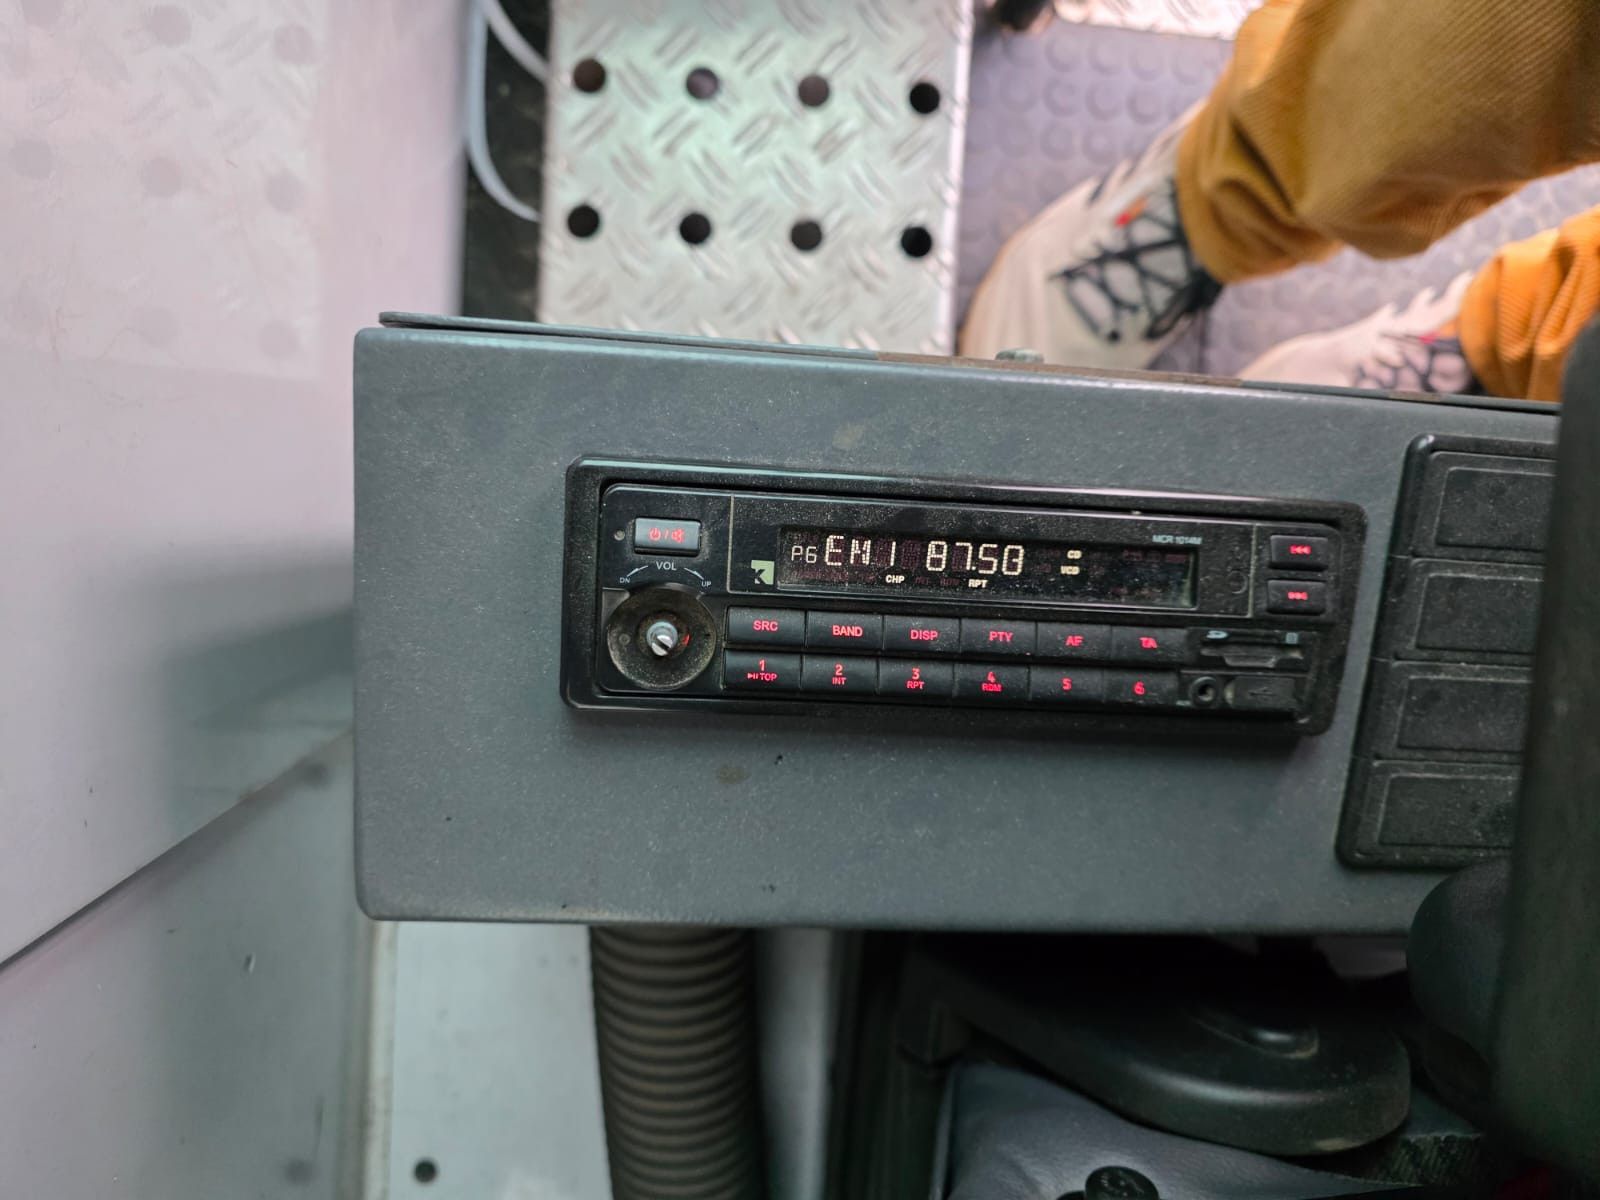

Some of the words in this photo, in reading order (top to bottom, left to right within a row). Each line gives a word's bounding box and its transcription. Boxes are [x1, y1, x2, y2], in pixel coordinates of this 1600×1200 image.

[656, 561, 677, 571] VOL
[753, 620, 778, 632] SRC
[832, 624, 863, 637] BAND
[910, 629, 938, 641] DISP
[989, 631, 1013, 643] PTY
[1065, 635, 1084, 647] AF
[758, 659, 766, 671] 1
[835, 664, 843, 676] 2
[760, 672, 777, 682] TOP
[911, 668, 920, 680] 3
[987, 671, 996, 682] 4
[832, 676, 847, 685] INT
[907, 680, 924, 690] RPT
[1134, 681, 1145, 695] 6
